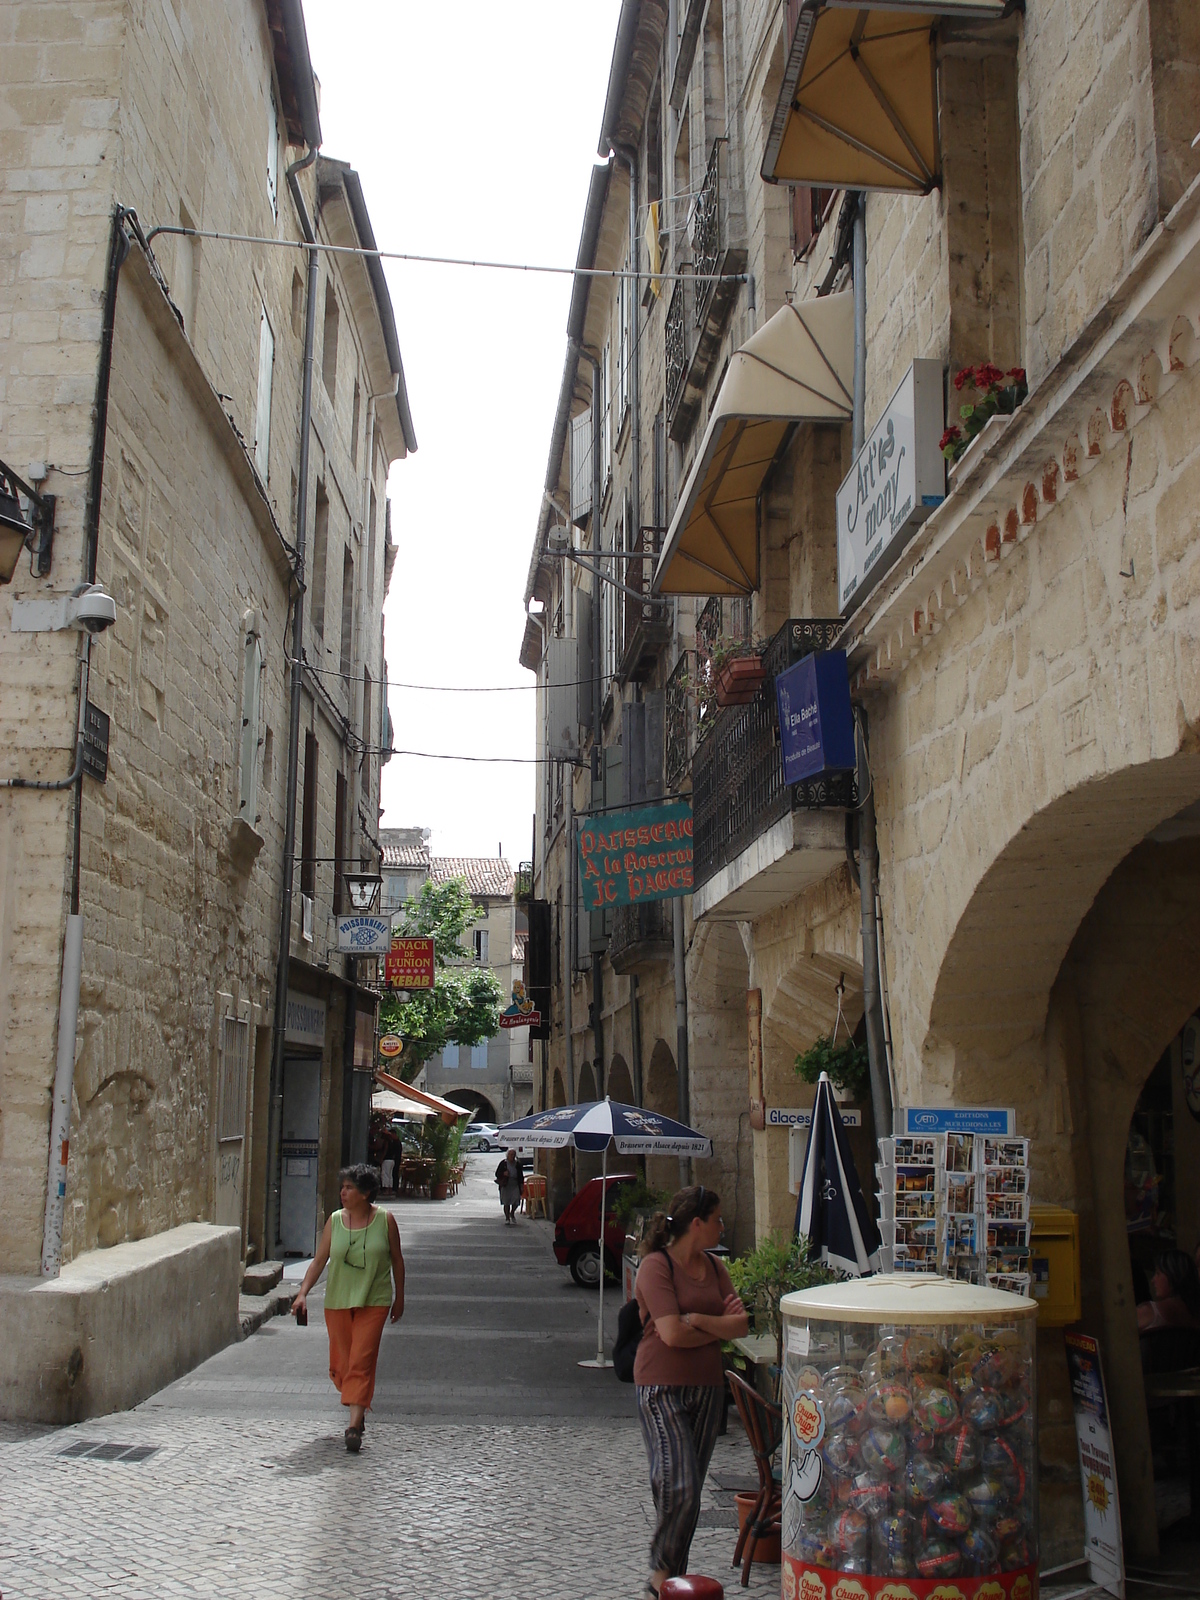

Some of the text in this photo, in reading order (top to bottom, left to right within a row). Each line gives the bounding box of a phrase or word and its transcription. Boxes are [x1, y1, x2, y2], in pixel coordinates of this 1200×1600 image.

[865, 446, 906, 546] mony
[790, 712, 801, 727] Ella
[584, 845, 694, 879] A la Roserai
[627, 866, 694, 901] PAGES
[339, 917, 388, 934] POISSONNERIE
[391, 940, 429, 950] SNACK
[388, 958, 431, 967] L'UNION
[390, 975, 430, 987] KEBAB
[770, 1109, 811, 1124] Glaces
[944, 1120, 1002, 1128] MERIDIONALES
[525, 1134, 539, 1142] Alsace
[539, 1135, 553, 1144] depuis
[553, 1136, 565, 1144] 1821
[620, 1141, 645, 1149] Brasseur
[653, 1141, 671, 1149] Alsace
[671, 1142, 690, 1151] depuis
[691, 1143, 705, 1151] 1821
[1065, 1335, 1096, 1352] NOUVEAU
[797, 1402, 818, 1423] Chupa
[795, 1412, 815, 1433] Chups
[1080, 1438, 1091, 1452] Tous
[801, 1578, 824, 1595] Chupa
[836, 1588, 867, 1600] Chupa
